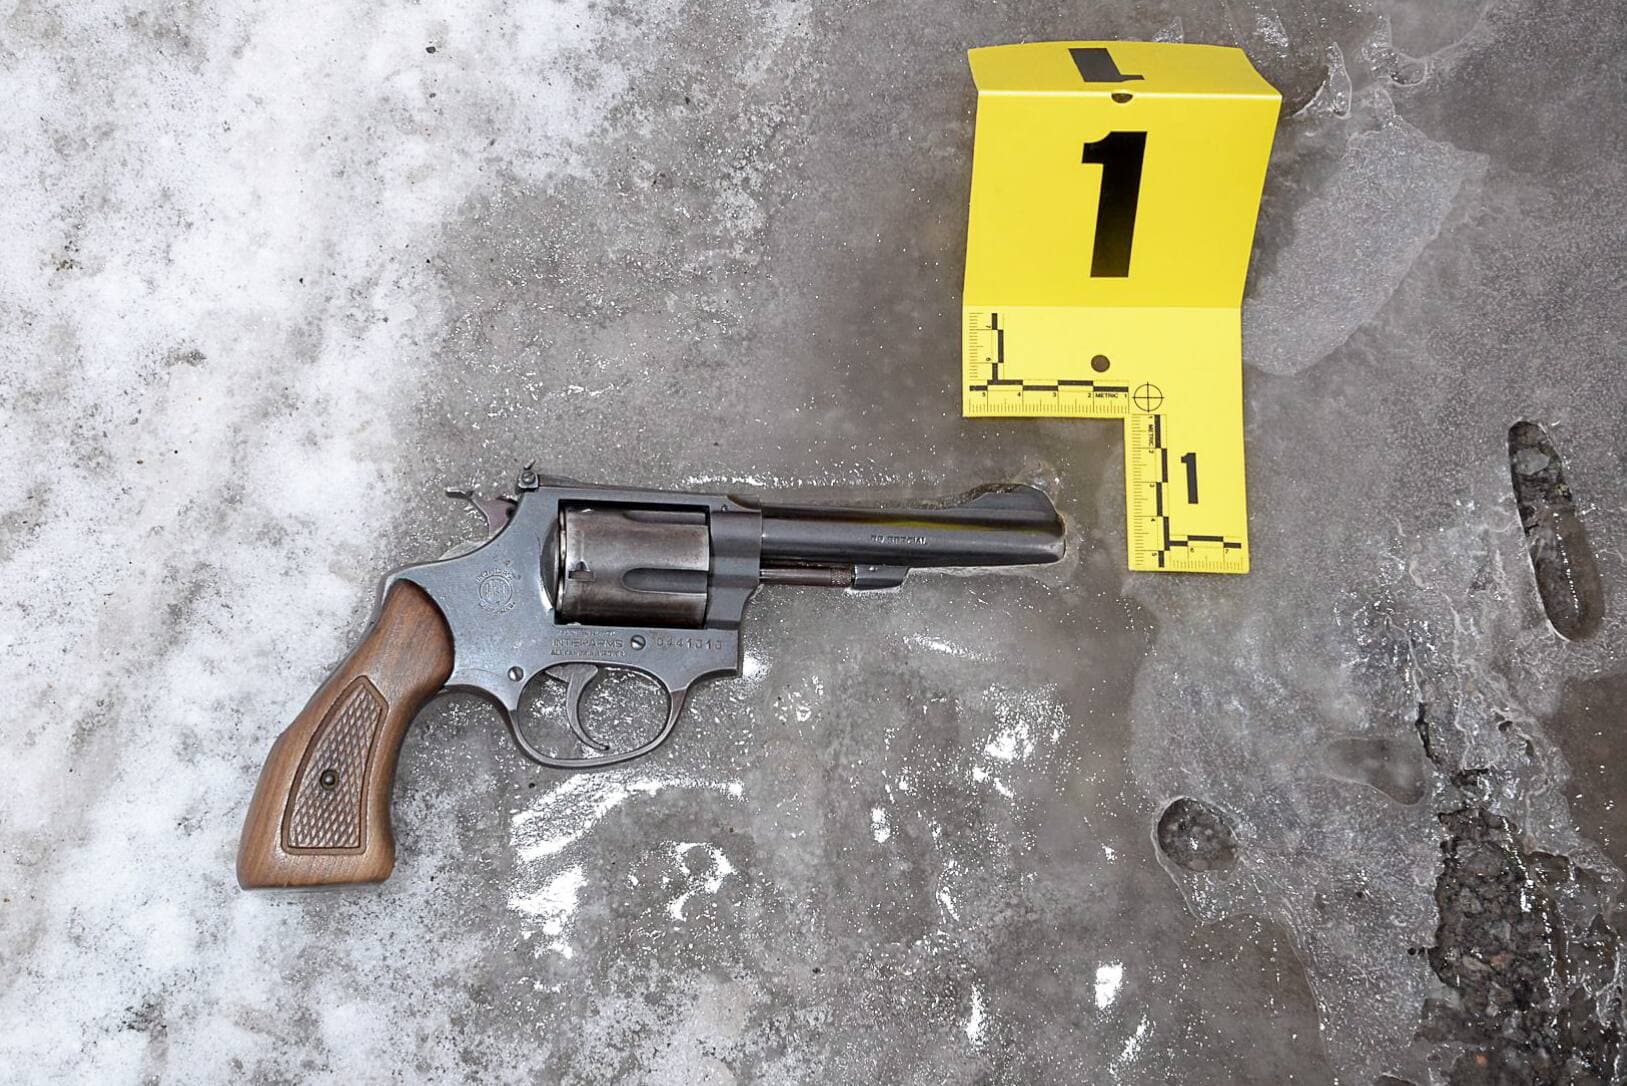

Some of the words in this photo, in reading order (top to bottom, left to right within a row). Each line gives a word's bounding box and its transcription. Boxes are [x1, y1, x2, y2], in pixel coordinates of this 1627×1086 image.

[1067, 47, 1145, 83] 1
[1081, 130, 1148, 278] 1
[1181, 452, 1199, 504] 1
